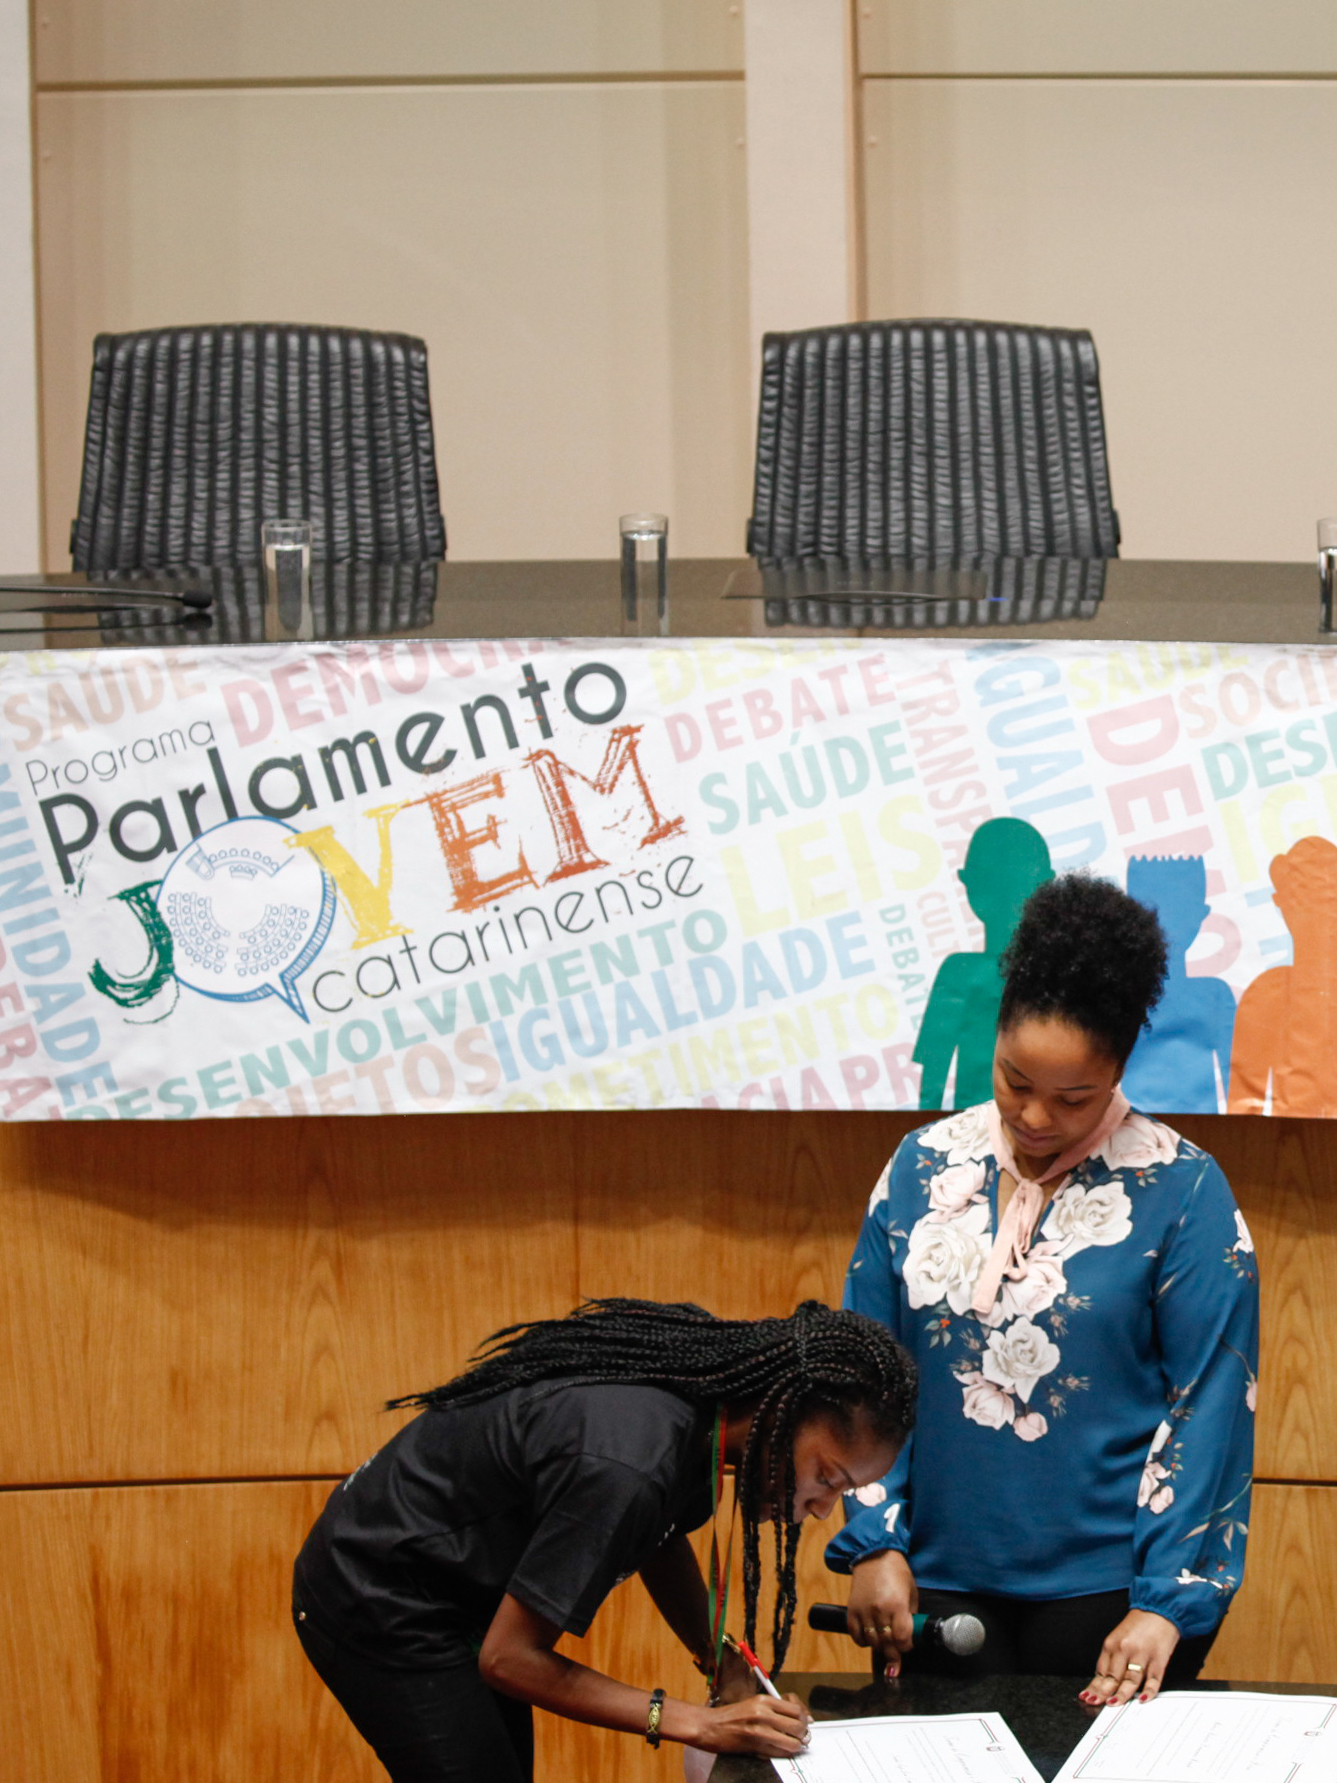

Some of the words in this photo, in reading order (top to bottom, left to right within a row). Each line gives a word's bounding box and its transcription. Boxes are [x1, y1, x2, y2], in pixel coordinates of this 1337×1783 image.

[25, 720, 216, 797] Programa
[38, 661, 627, 887] Parlamento
[663, 653, 896, 764] DEBATE
[698, 719, 916, 835] SAÚDE
[312, 855, 703, 1013] catarinense
[719, 794, 943, 938] LEIS
[489, 910, 877, 1083] IGUALDADE
